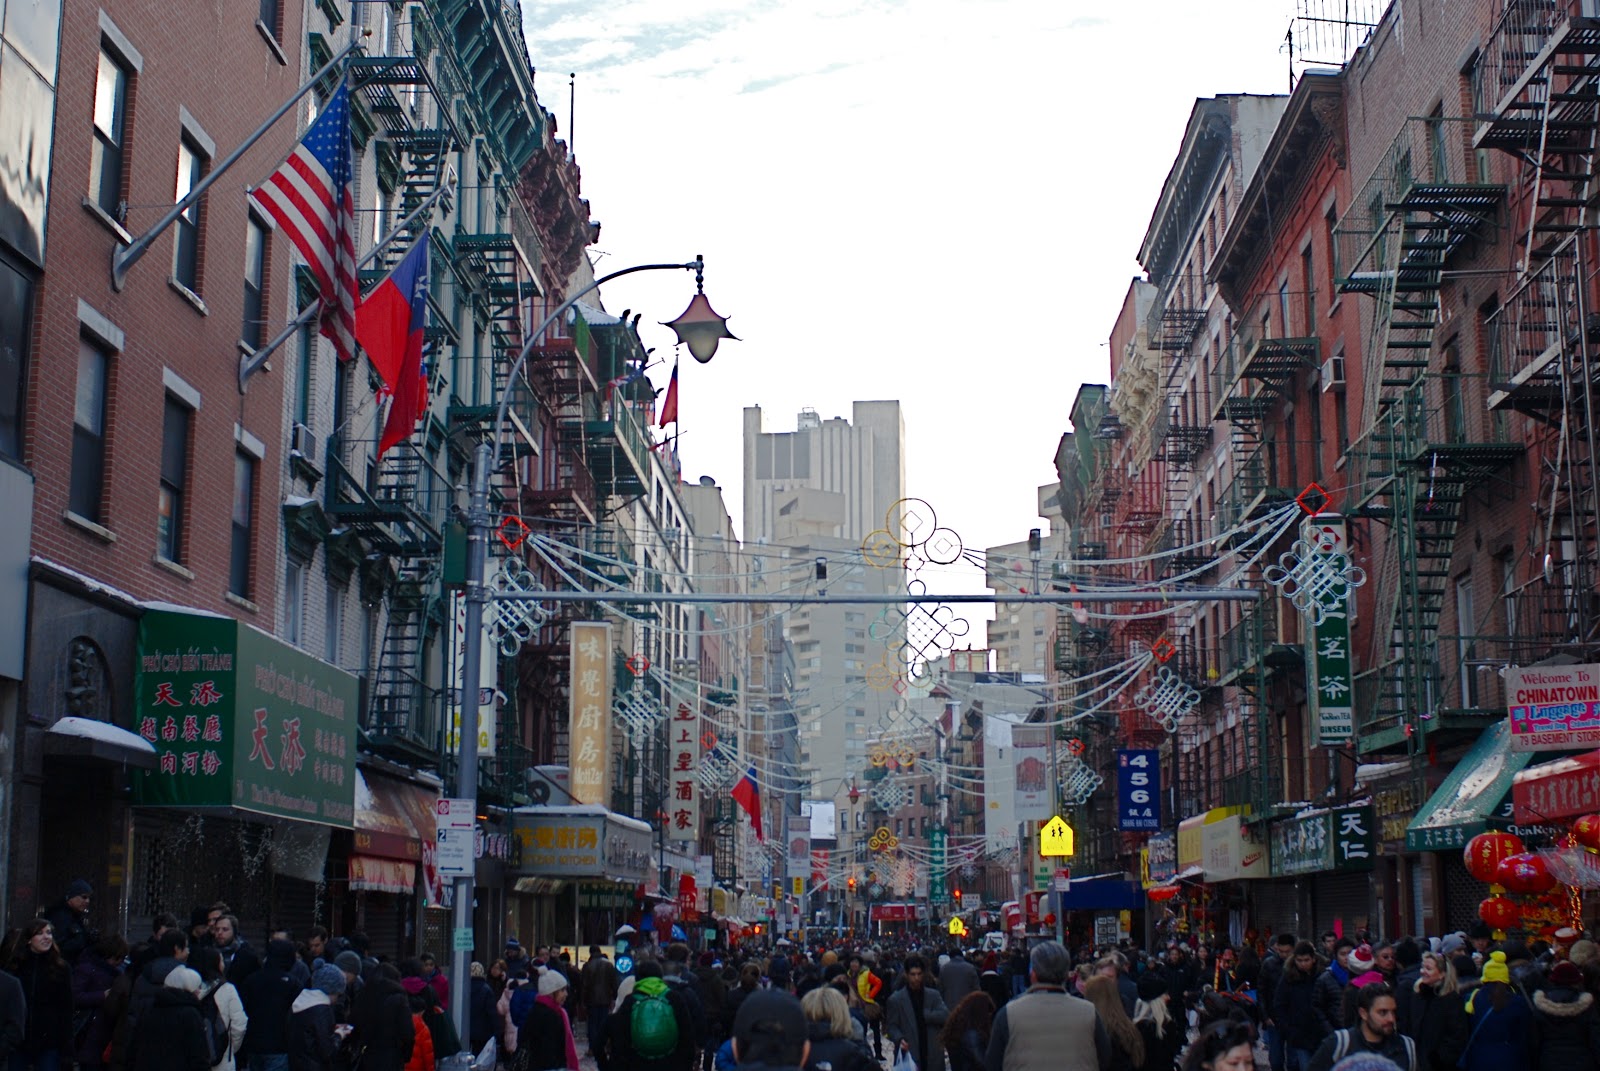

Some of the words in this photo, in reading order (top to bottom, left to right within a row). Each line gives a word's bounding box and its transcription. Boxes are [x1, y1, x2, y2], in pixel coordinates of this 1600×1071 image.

[1520, 673, 1572, 685] Welcome
[1576, 671, 1590, 682] To
[1517, 685, 1598, 704] CHINATOWN
[1530, 703, 1586, 720] Luggage
[1321, 725, 1352, 734] GINSENG
[1532, 732, 1574, 745] BASEMENT
[439, 830, 446, 843] 2
[1339, 813, 1369, 860] 天仁
